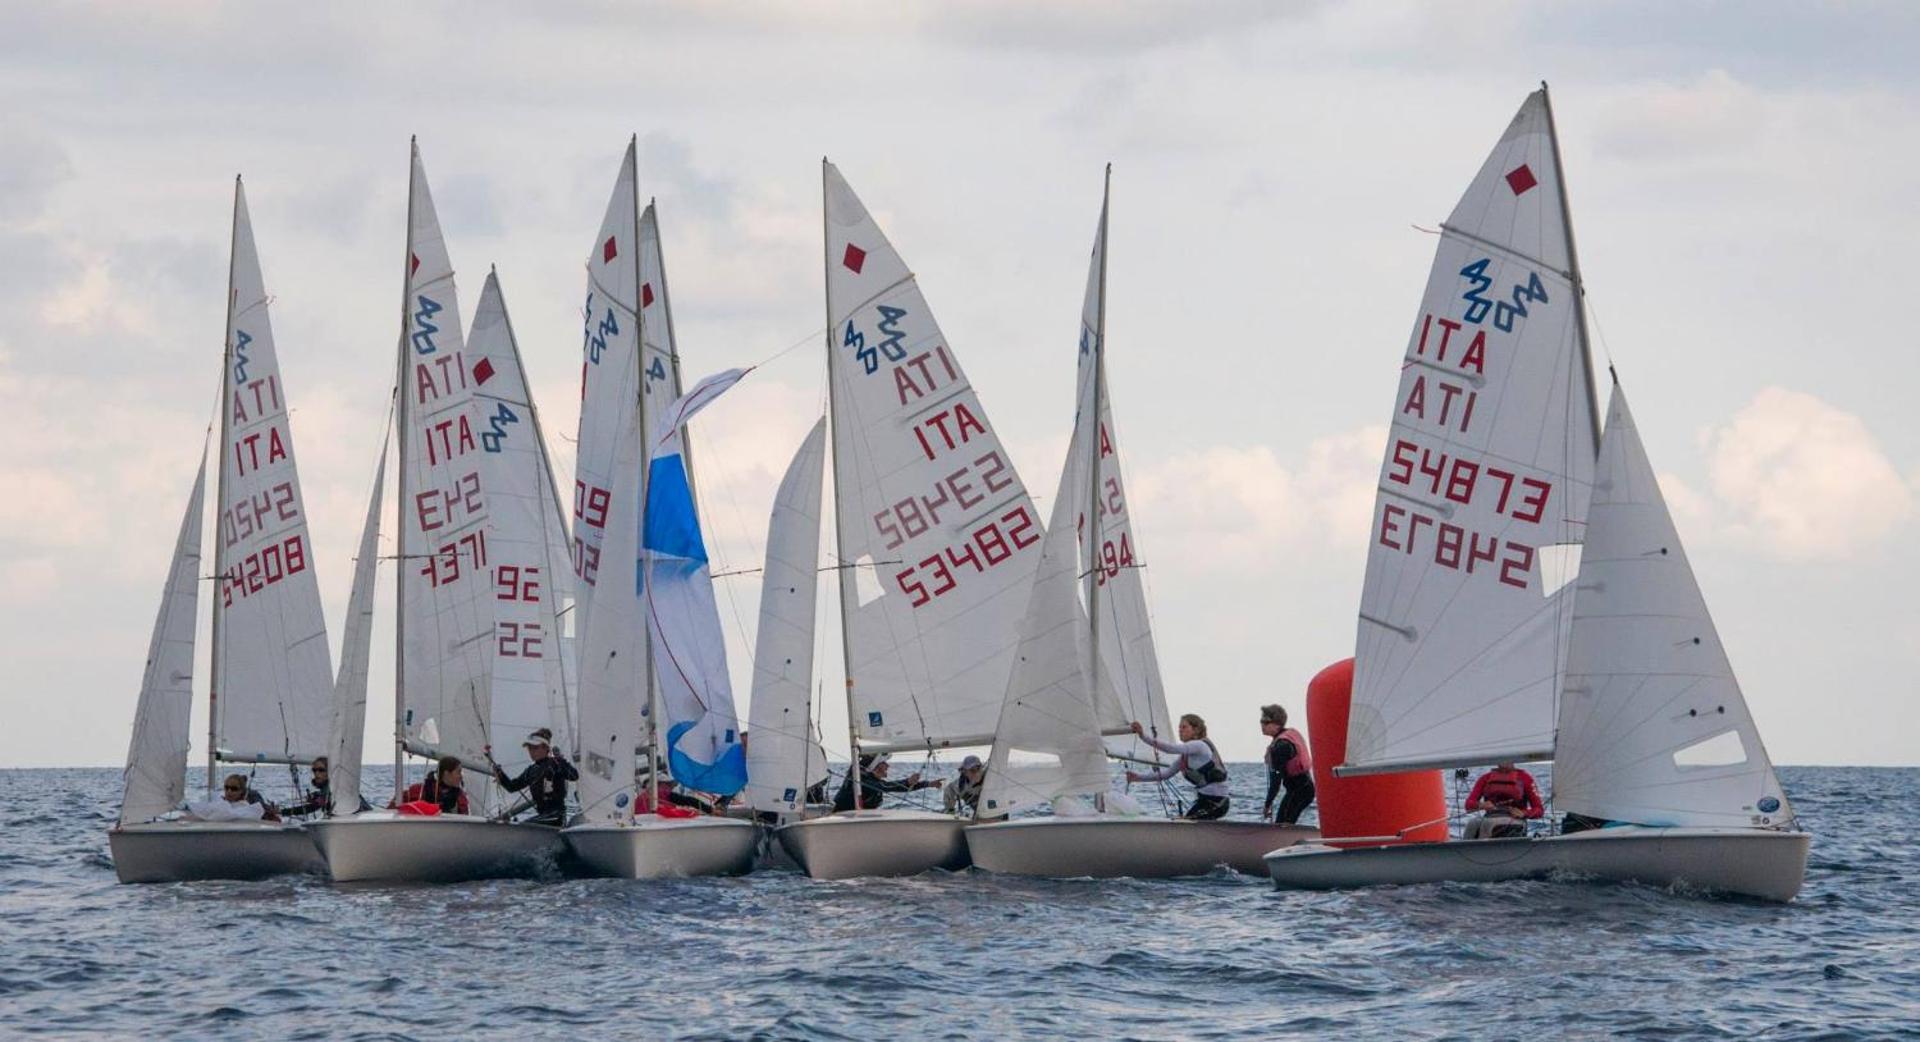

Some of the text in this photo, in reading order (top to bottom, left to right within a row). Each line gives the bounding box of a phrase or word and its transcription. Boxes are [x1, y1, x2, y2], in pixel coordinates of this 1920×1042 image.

[1417, 313, 1487, 375] ITA
[235, 427, 287, 478] ITA
[425, 414, 476, 467] ITA
[912, 402, 986, 461] ITA
[1389, 439, 1552, 524] 54873
[223, 535, 305, 609] 54208
[896, 505, 1040, 609] 53482
